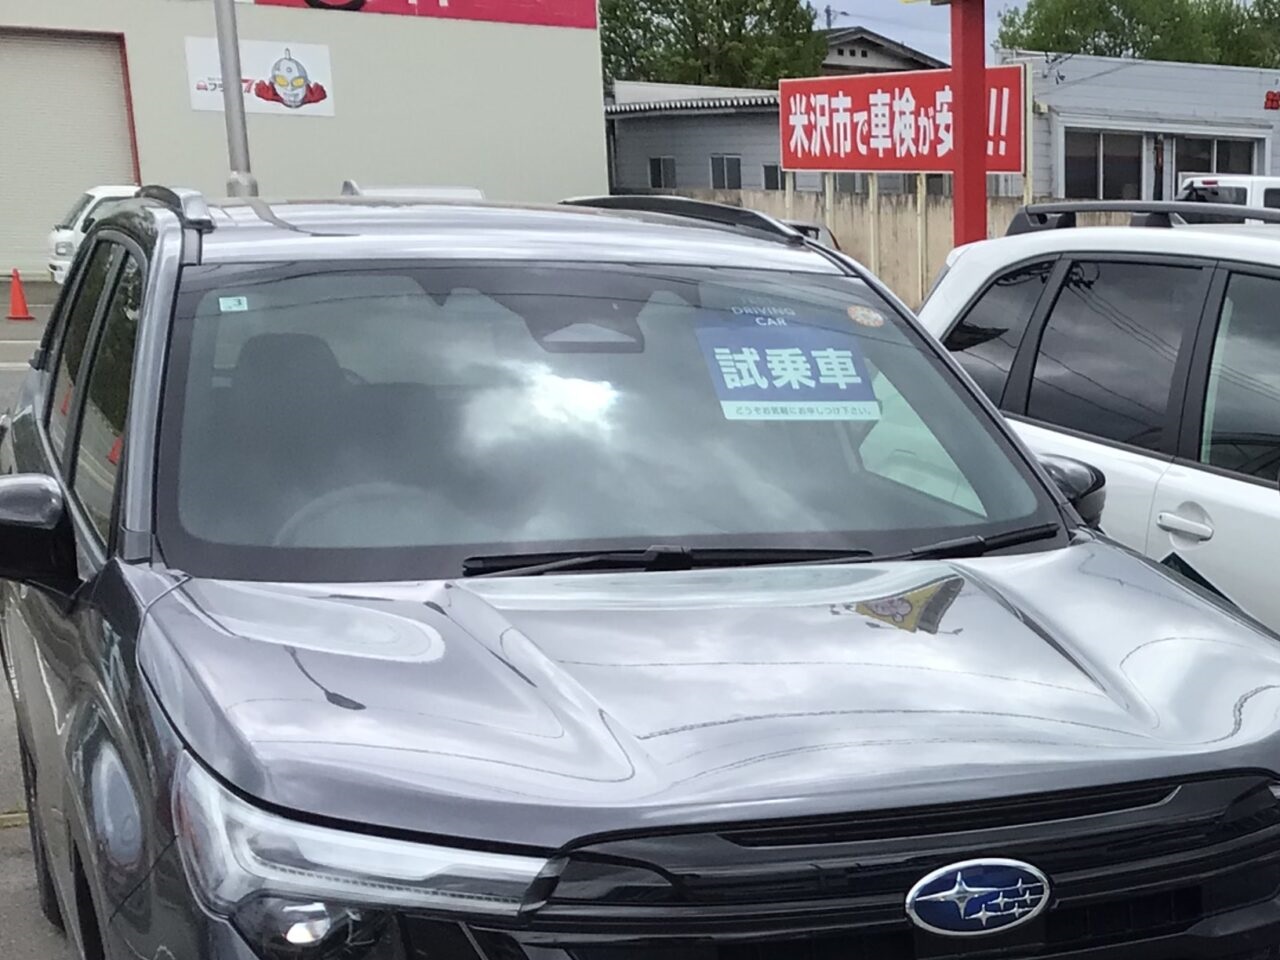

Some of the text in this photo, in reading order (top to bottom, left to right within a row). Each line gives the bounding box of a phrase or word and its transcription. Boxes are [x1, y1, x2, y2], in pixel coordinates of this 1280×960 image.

[788, 85, 1010, 158] 米沢市で車検が安!!
[755, 316, 788, 327] CAR
[713, 347, 862, 390] 試乗車
